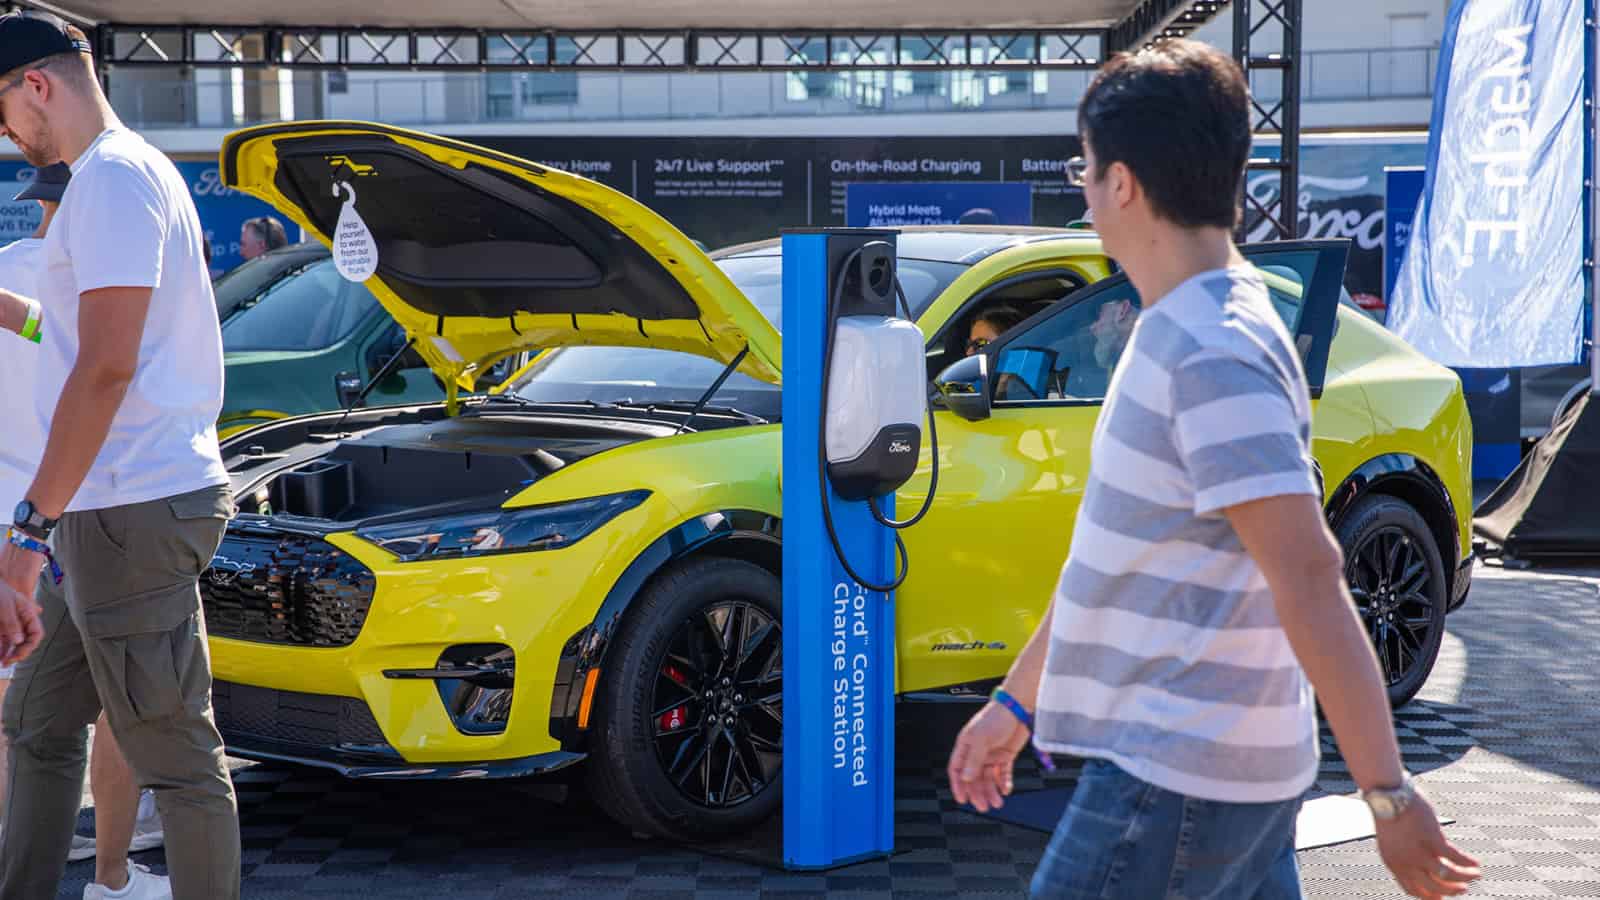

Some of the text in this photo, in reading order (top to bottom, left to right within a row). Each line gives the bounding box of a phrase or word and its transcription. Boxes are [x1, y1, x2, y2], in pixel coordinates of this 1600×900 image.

[571, 159, 612, 171] Home
[655, 159, 682, 172] 24/7
[686, 159, 713, 172] Live
[831, 159, 981, 175] On-the-Road Charging
[868, 204, 942, 217] Hybrid Meets
[831, 582, 850, 769] Charge Station
[852, 653, 868, 787] Connected
